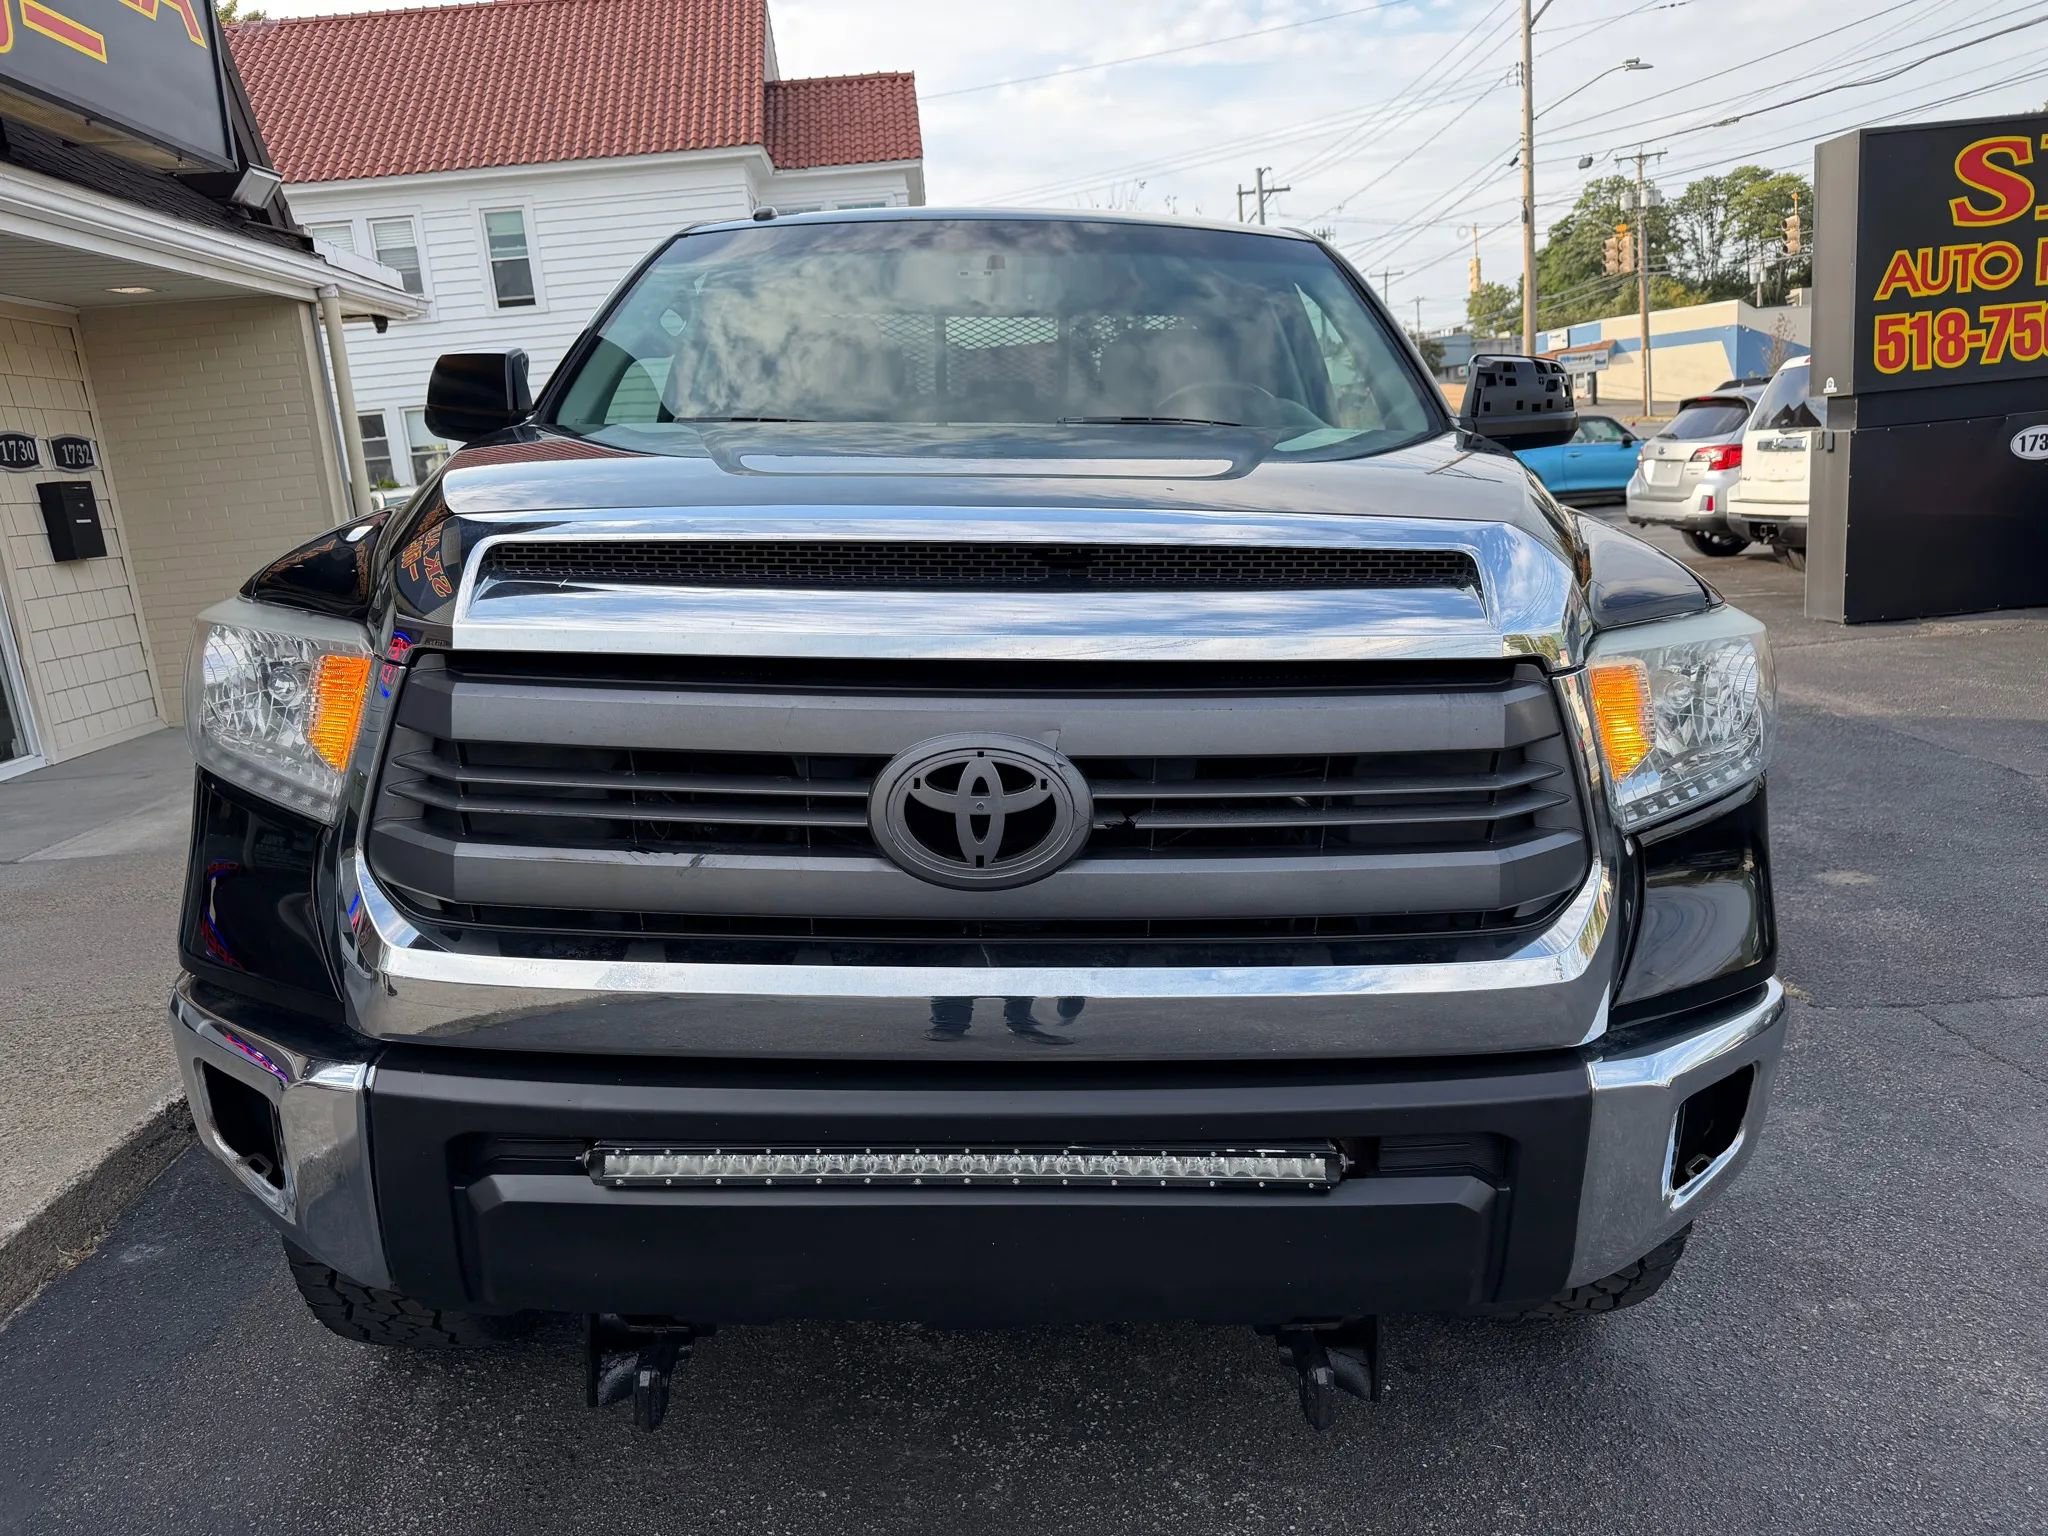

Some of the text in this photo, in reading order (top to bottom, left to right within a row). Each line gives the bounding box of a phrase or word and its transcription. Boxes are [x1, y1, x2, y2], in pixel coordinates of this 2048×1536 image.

[1949, 134, 2048, 227] S
[1873, 240, 2024, 301] AUTO
[1873, 300, 2048, 374] 518-75
[0, 440, 36, 462] 1730
[61, 444, 93, 465] 1732
